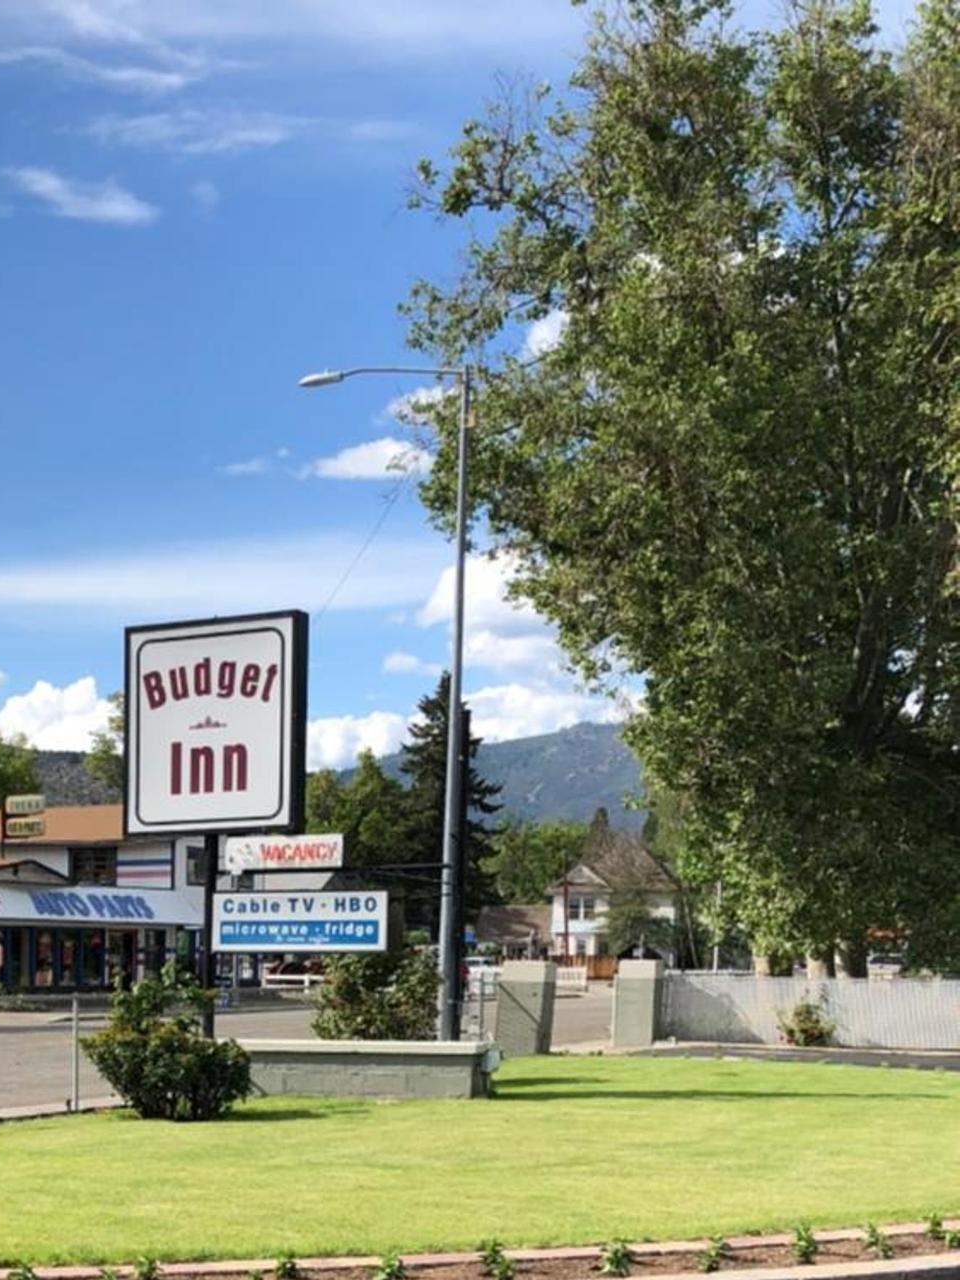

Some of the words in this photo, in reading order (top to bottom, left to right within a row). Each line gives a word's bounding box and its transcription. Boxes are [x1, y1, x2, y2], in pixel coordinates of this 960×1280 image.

[143, 657, 278, 710] Budget
[170, 741, 247, 795] Inn
[259, 841, 337, 862] VACANCY
[28, 890, 91, 916] AUTO
[87, 894, 154, 919] PARTS
[222, 898, 281, 913] Cable
[288, 898, 314, 913] TV
[334, 897, 377, 912] HBO
[221, 923, 309, 935] microwave
[324, 923, 375, 937] fridge
